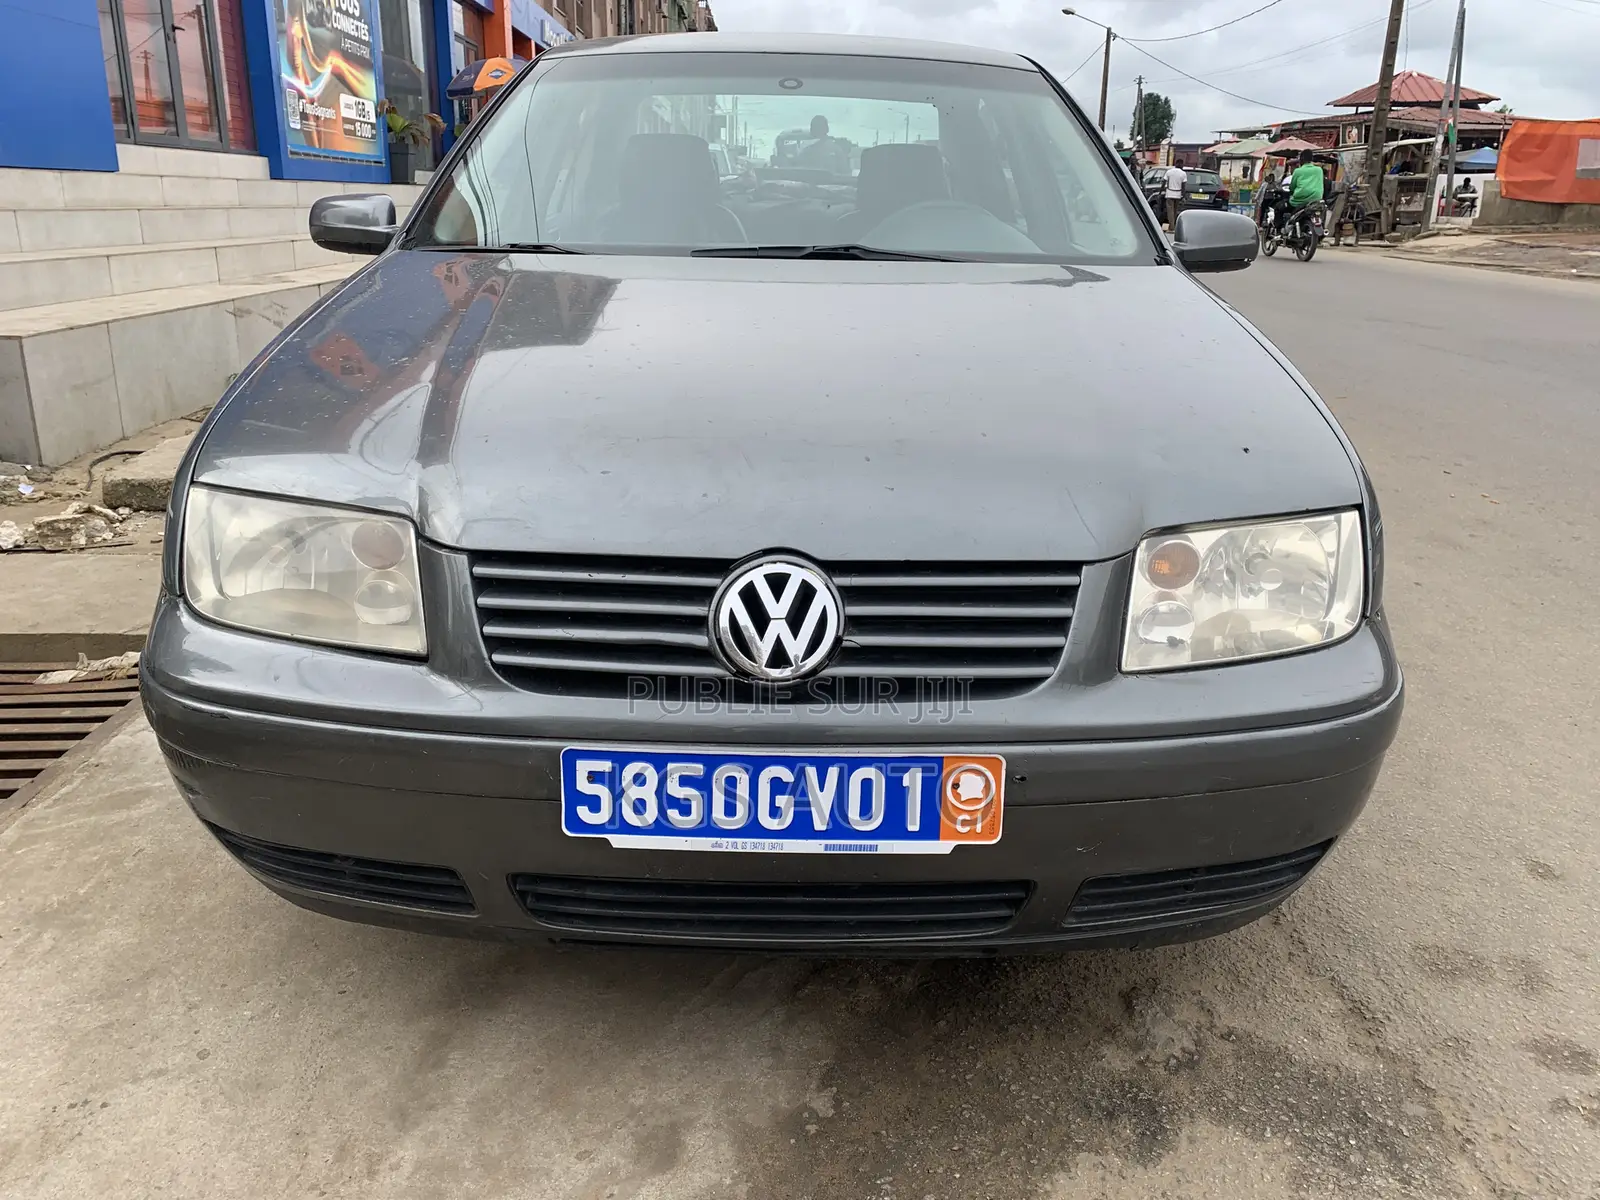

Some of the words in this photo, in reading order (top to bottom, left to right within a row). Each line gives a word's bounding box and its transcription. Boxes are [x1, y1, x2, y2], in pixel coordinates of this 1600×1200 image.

[332, 10, 369, 41] CONNECTÉS
[575, 759, 923, 832] 5850GV01
[955, 814, 983, 834] CI
